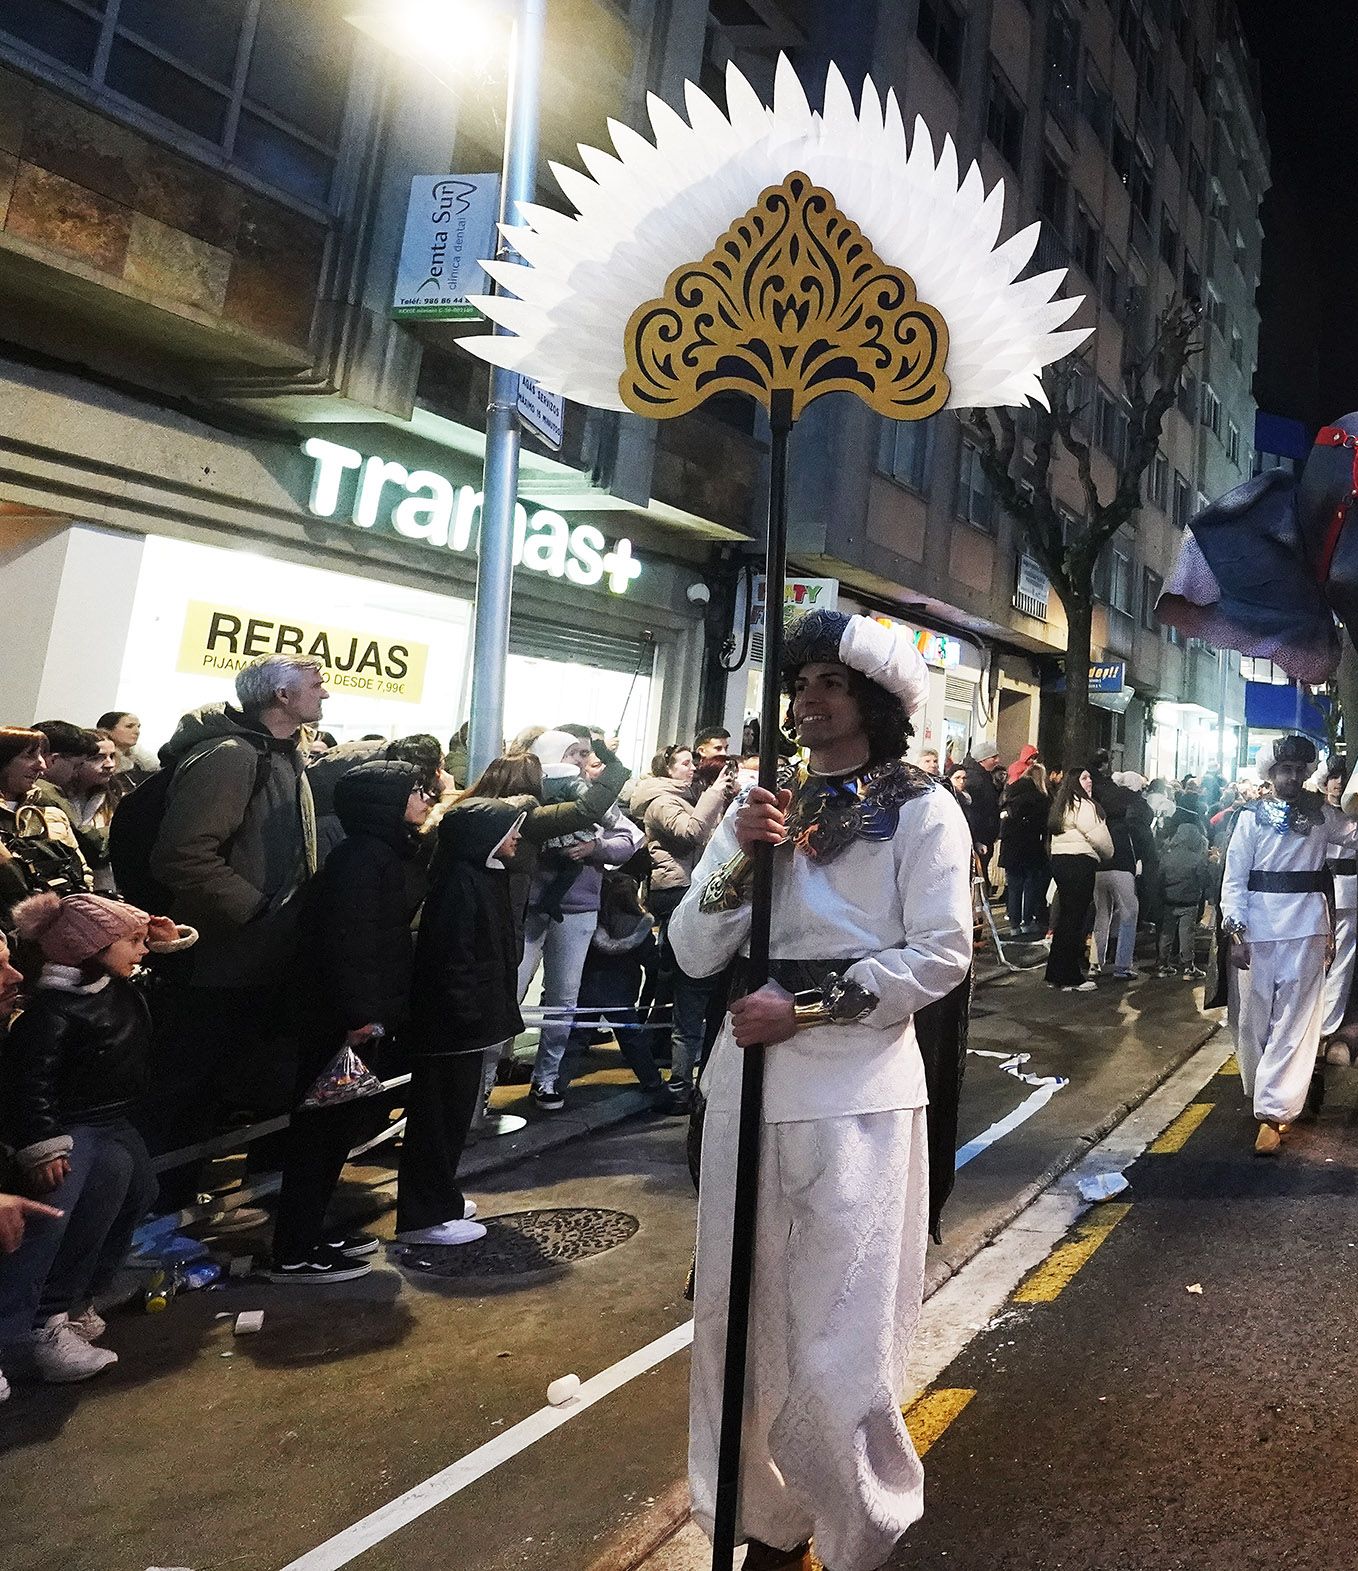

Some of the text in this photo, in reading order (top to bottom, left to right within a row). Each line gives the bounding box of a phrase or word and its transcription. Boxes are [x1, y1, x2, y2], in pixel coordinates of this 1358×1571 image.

[431, 185, 455, 224] Sur
[453, 217, 466, 253] dental
[206, 611, 409, 679] REBAJAS
[334, 673, 373, 690] DESDE
[377, 680, 405, 694] 7,99€
